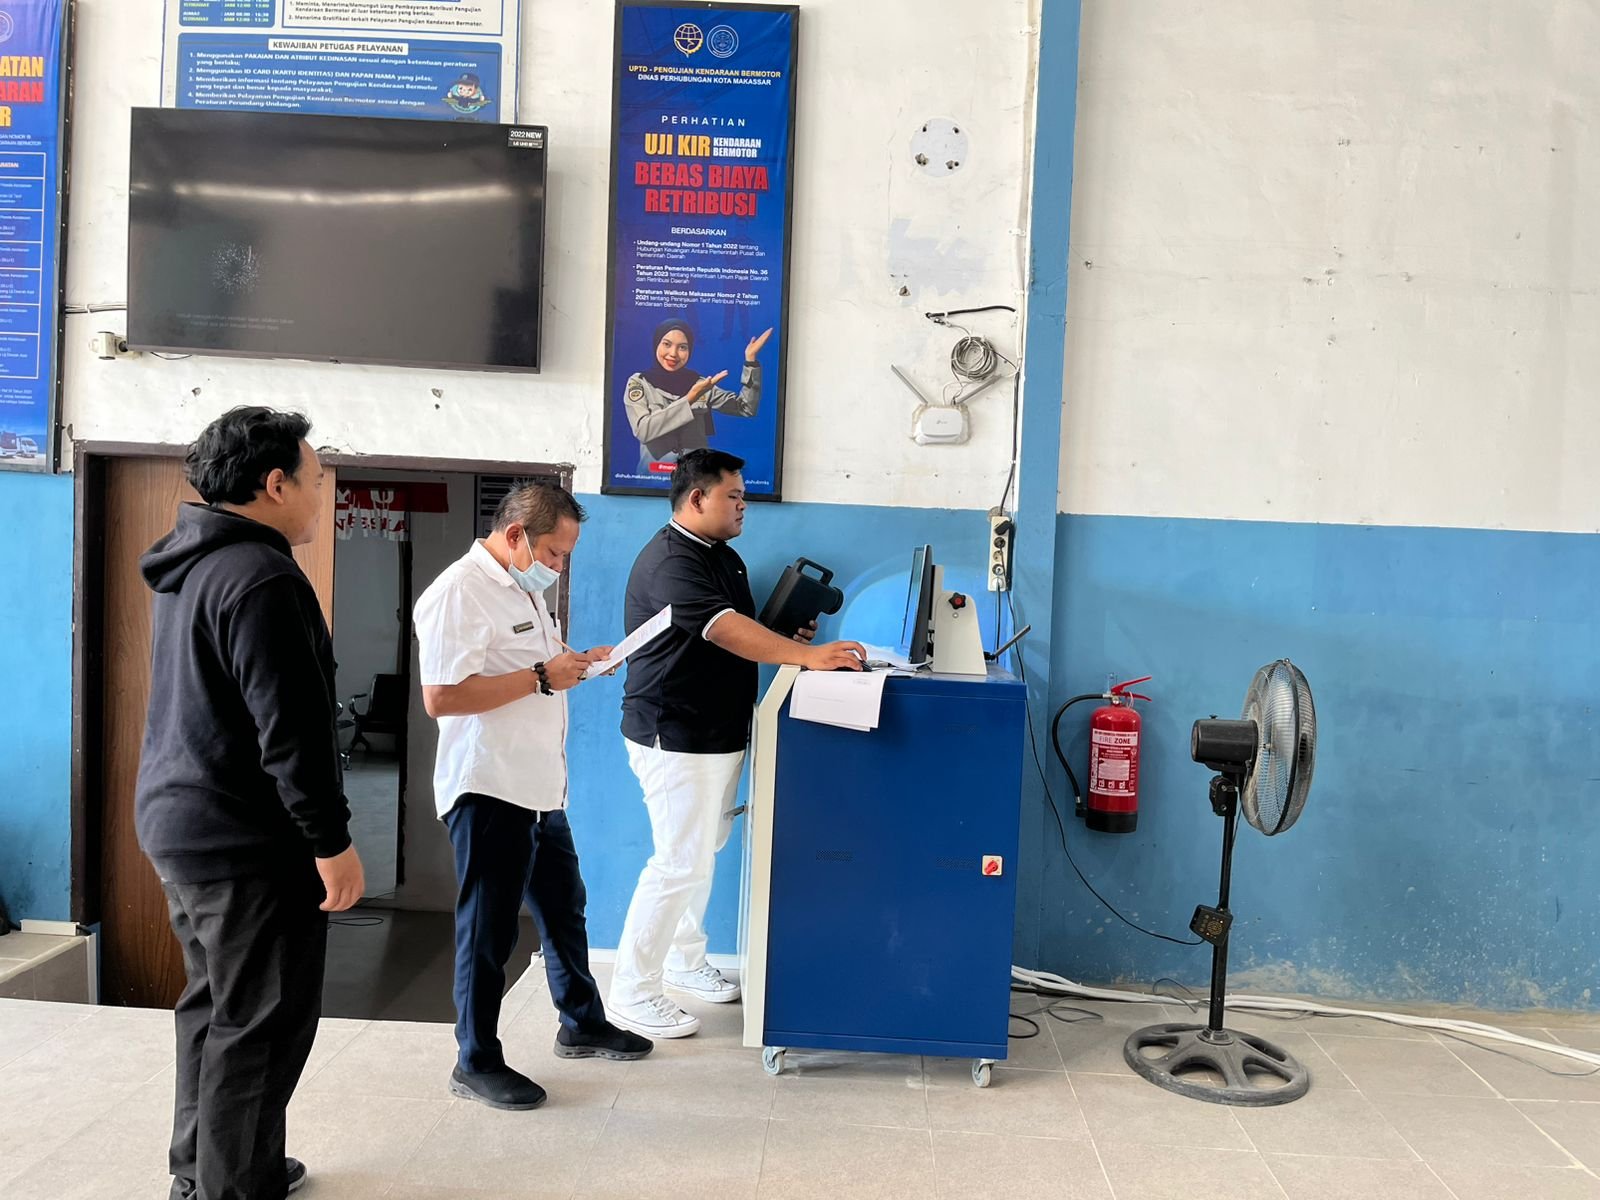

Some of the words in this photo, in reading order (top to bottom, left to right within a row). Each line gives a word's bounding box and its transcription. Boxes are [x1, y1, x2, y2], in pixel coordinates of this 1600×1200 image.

[273, 41, 318, 50] KEWAJIBAN
[320, 42, 354, 51] PETUGAS
[357, 43, 403, 52] PELAYANAN
[197, 52, 243, 60] Menggunakan
[381, 58, 406, 66] dengan
[443, 61, 477, 69] peraturan
[629, 65, 648, 73] UPTD
[654, 66, 694, 74] PENGUJIAN
[696, 68, 739, 76] KENDARAAN
[741, 70, 781, 78] BERMOTOR
[271, 78, 297, 86] tentang
[334, 80, 367, 88] Pengujian
[660, 75, 712, 83] PERHUBUNGAN
[733, 78, 772, 86] MAKASSAR
[662, 115, 746, 127] PERHATIAN
[510, 130, 525, 138] 2022
[644, 133, 673, 156] UJI
[677, 134, 711, 157] KIR
[713, 137, 762, 149] KENDARAAN
[713, 147, 758, 158] BERMOTOR
[635, 161, 704, 188] BEBAS
[708, 163, 769, 190] BIAYA
[645, 188, 757, 216] RETRIBUSI
[671, 227, 727, 236] BERDASARKAN
[637, 240, 681, 248] Undang-undang
